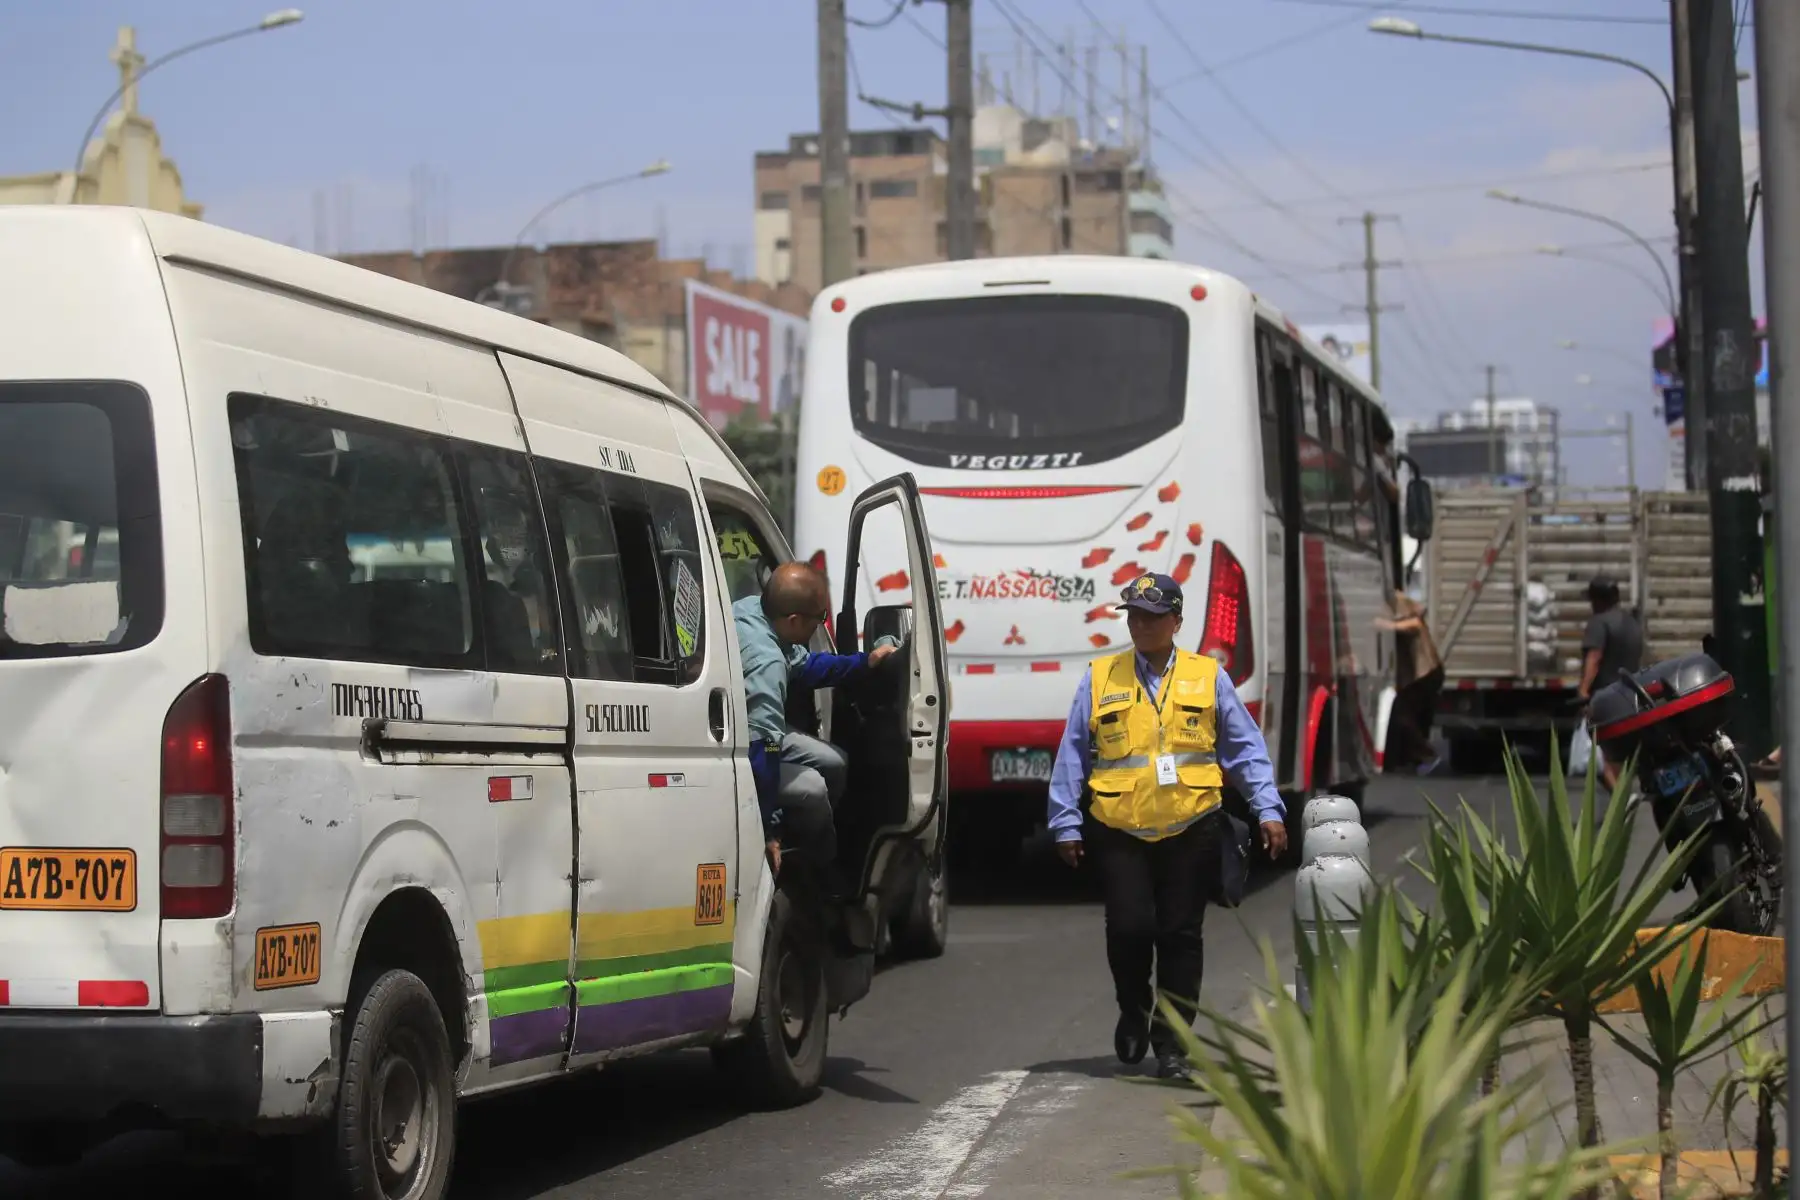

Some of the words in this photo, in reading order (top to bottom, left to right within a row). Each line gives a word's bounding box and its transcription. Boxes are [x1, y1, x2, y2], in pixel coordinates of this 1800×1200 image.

[705, 316, 760, 401] SALE
[949, 451, 1083, 470] VEGUZTI
[331, 683, 423, 720] MIRAFLORES
[3, 857, 126, 901] A7B-707
[258, 933, 317, 979] A7B-707
